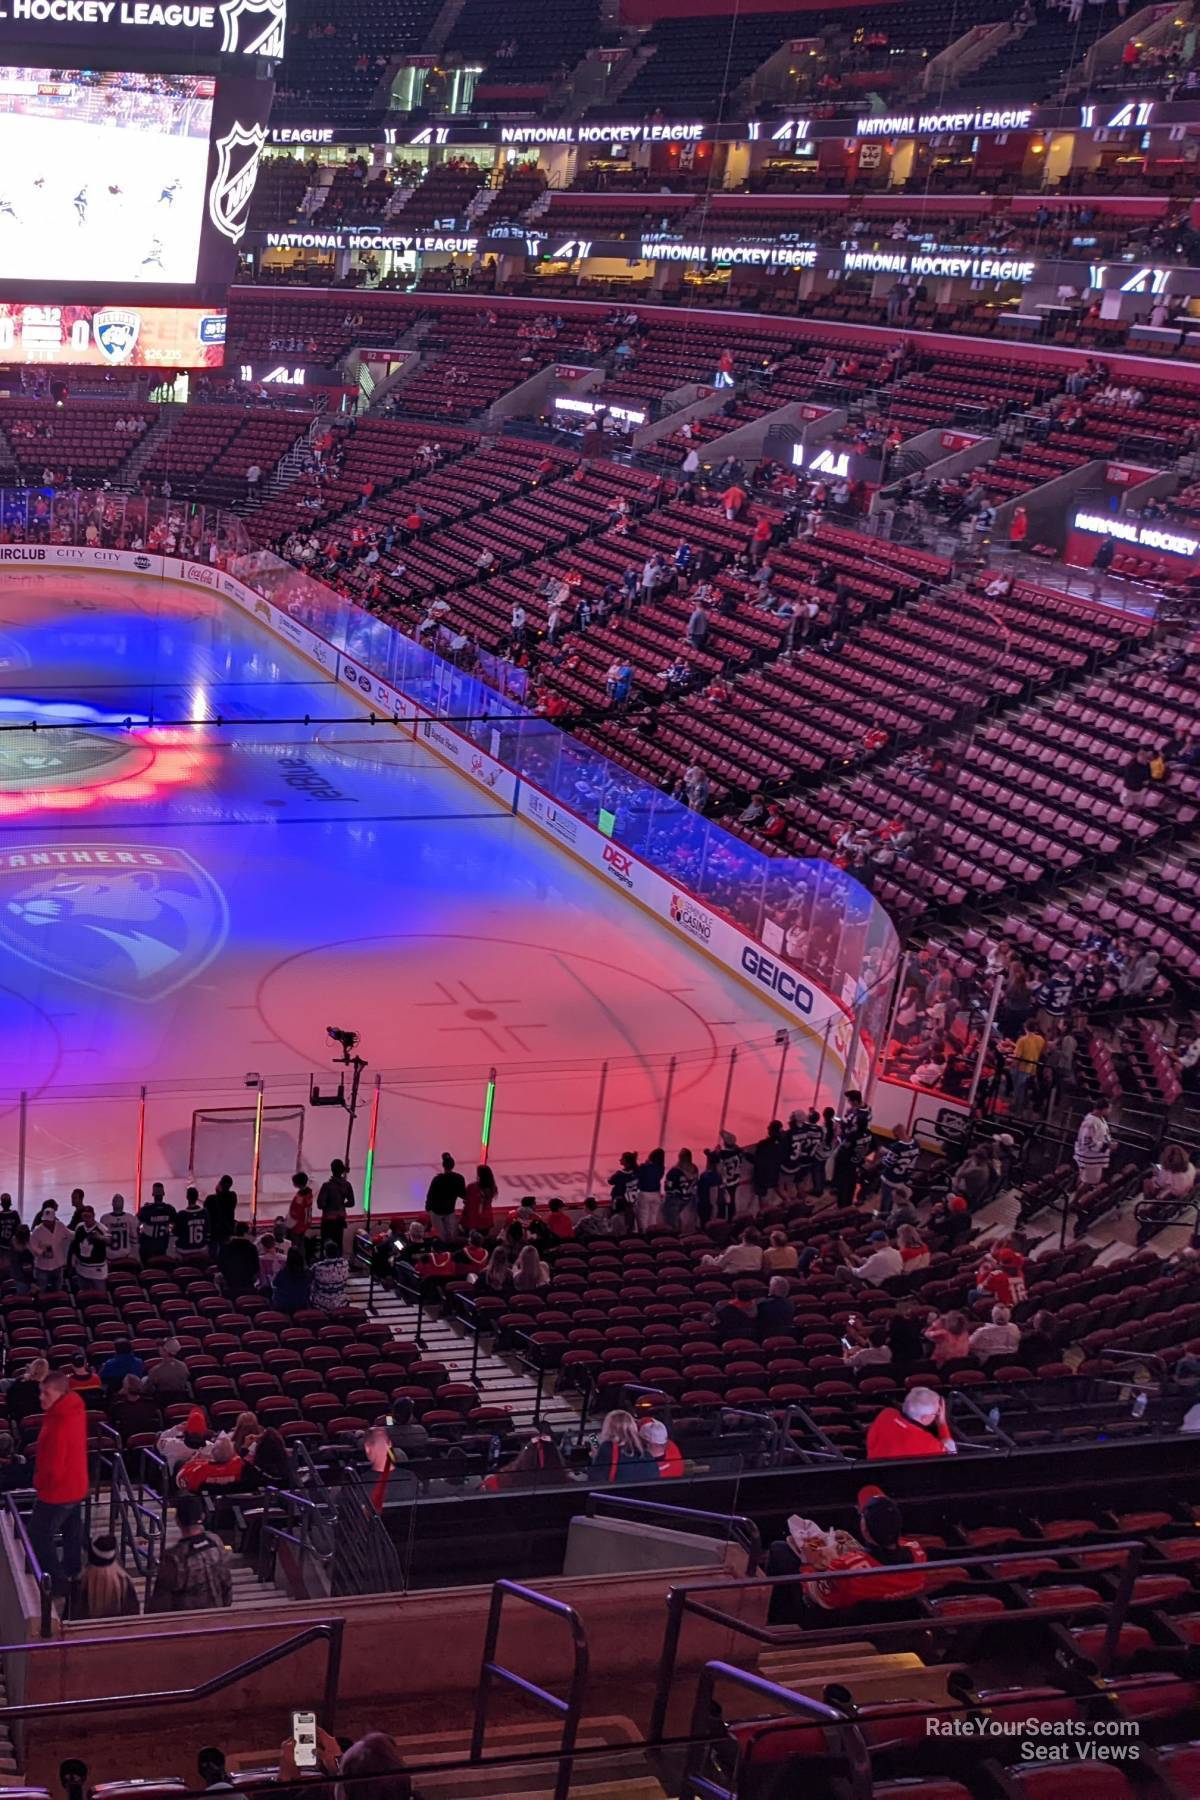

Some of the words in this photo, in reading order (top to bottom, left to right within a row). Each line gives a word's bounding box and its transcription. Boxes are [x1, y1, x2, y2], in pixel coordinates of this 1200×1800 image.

[14, 0, 116, 23] HOCKEY
[121, 4, 215, 28] LEAGUE
[272, 128, 333, 143] LEAGUE
[501, 127, 574, 143] NATIONAL
[578, 125, 641, 142] HOCKEY
[644, 125, 704, 141] LEAGUE
[857, 116, 915, 136] NATIONAL
[918, 113, 973, 133] HOCKEY
[975, 110, 1032, 130] LEAGUE
[267, 233, 345, 250] NATIONAL
[349, 235, 413, 251] HOCKEY
[415, 238, 479, 253] LEAGUE
[641, 243, 708, 261] NATIONAL
[711, 246, 770, 264] HOCKEY
[771, 249, 818, 268] LEAGUE
[844, 253, 907, 274] NATIONAL
[910, 256, 971, 278] HOCKEY
[972, 259, 1035, 282] LEAGUE
[72, 320, 90, 351] 0
[57, 548, 85, 558] CITY
[1140, 528, 1199, 556] HOCKEY
[94, 551, 121, 561] CITY
[602, 844, 634, 877] DEX
[682, 911, 711, 939] CASINO
[741, 945, 814, 1015] GEICO
[188, 1224, 204, 1244] 16
